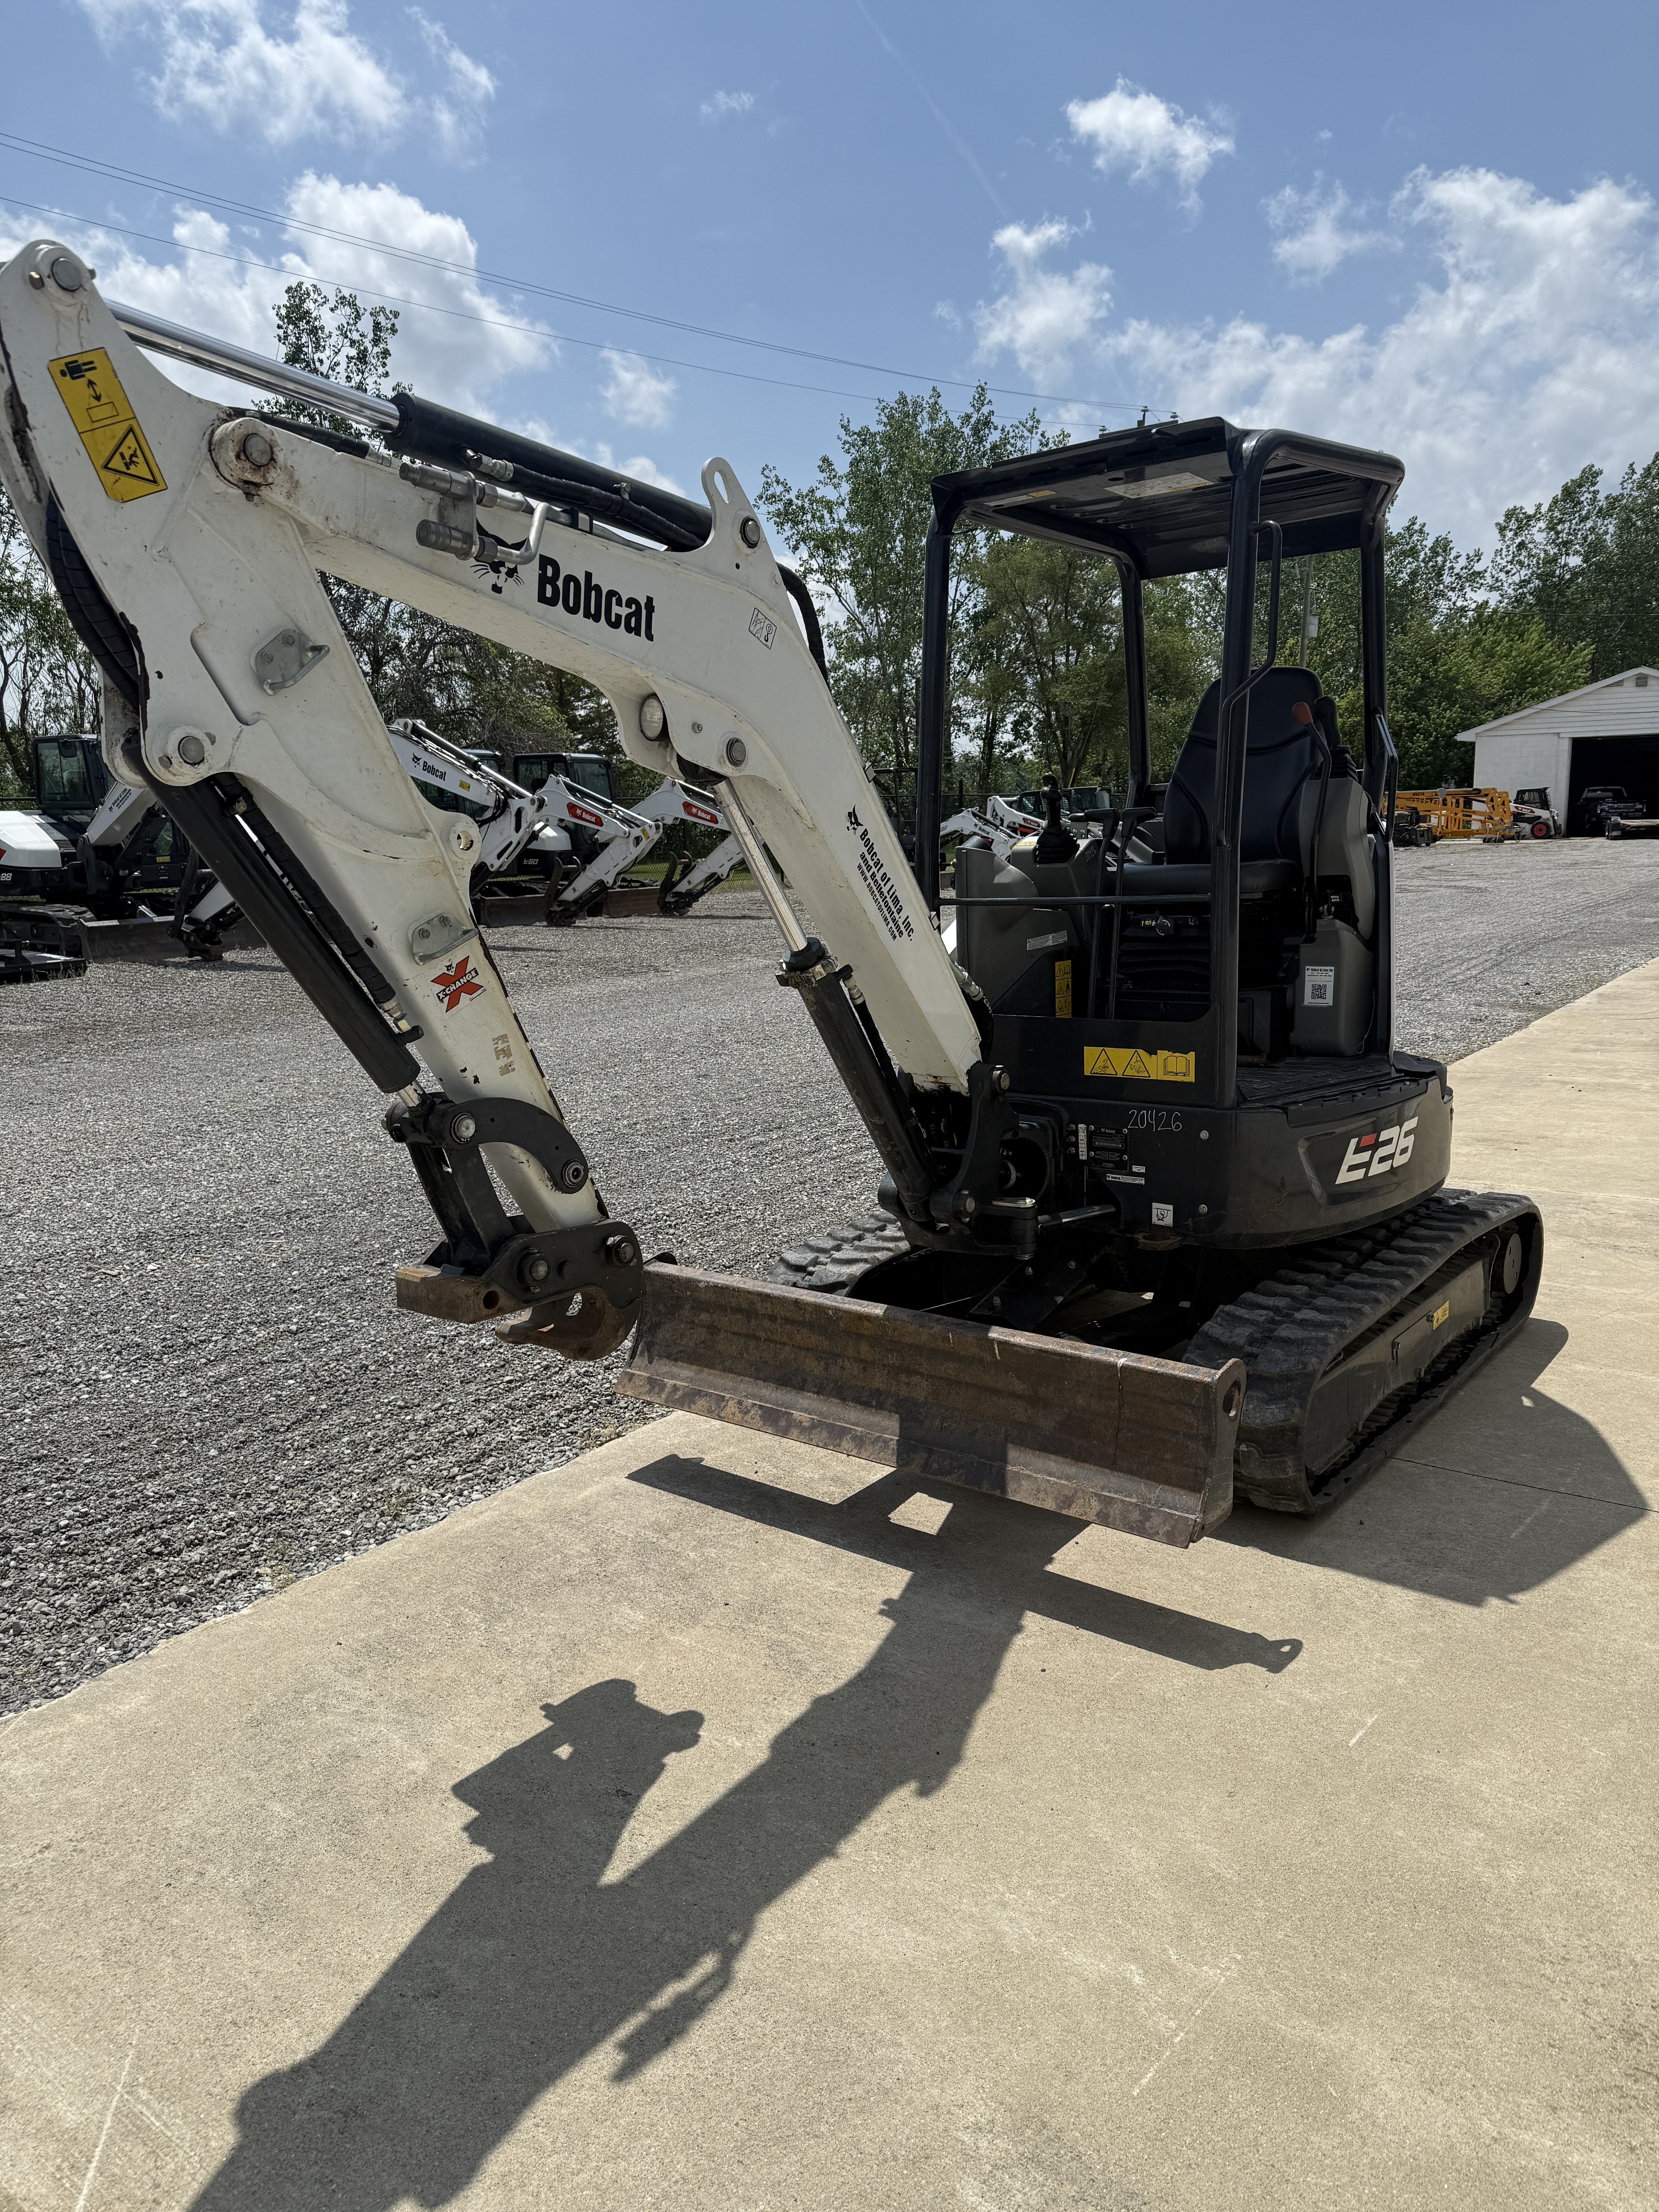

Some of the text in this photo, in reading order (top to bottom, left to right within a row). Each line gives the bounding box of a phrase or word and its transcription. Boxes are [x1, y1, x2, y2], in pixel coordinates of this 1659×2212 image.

[538, 553, 655, 642] Bobcat
[422, 761, 446, 781] Bobcat
[860, 828, 914, 941] Bobcat of Lima, Inc.
[860, 852, 903, 938] and Bellefontaine
[438, 970, 477, 999] X-CHANGE
[1128, 1109, 1182, 1132] 20426
[1335, 1116, 1419, 1185] E26
